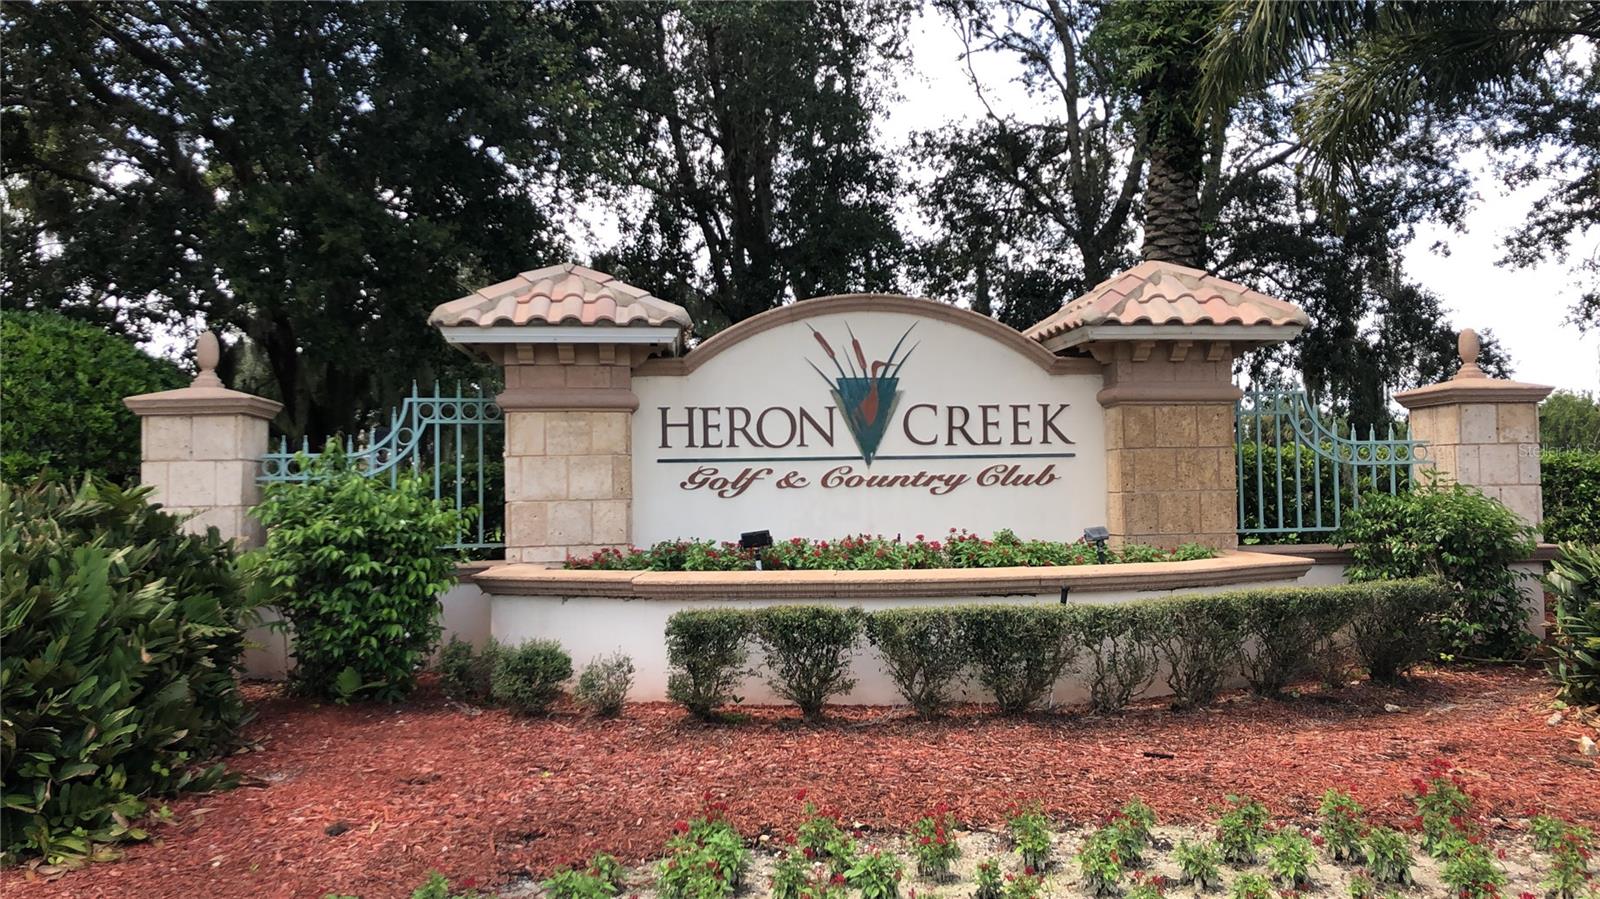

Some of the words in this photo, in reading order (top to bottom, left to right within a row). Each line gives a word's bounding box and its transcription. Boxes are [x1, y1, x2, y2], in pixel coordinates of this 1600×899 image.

[657, 406, 836, 448] HERON
[902, 404, 1076, 446] CREEK
[680, 466, 773, 498] Golf
[776, 470, 811, 489] &
[820, 465, 972, 496] Country
[976, 463, 1062, 487] Club
